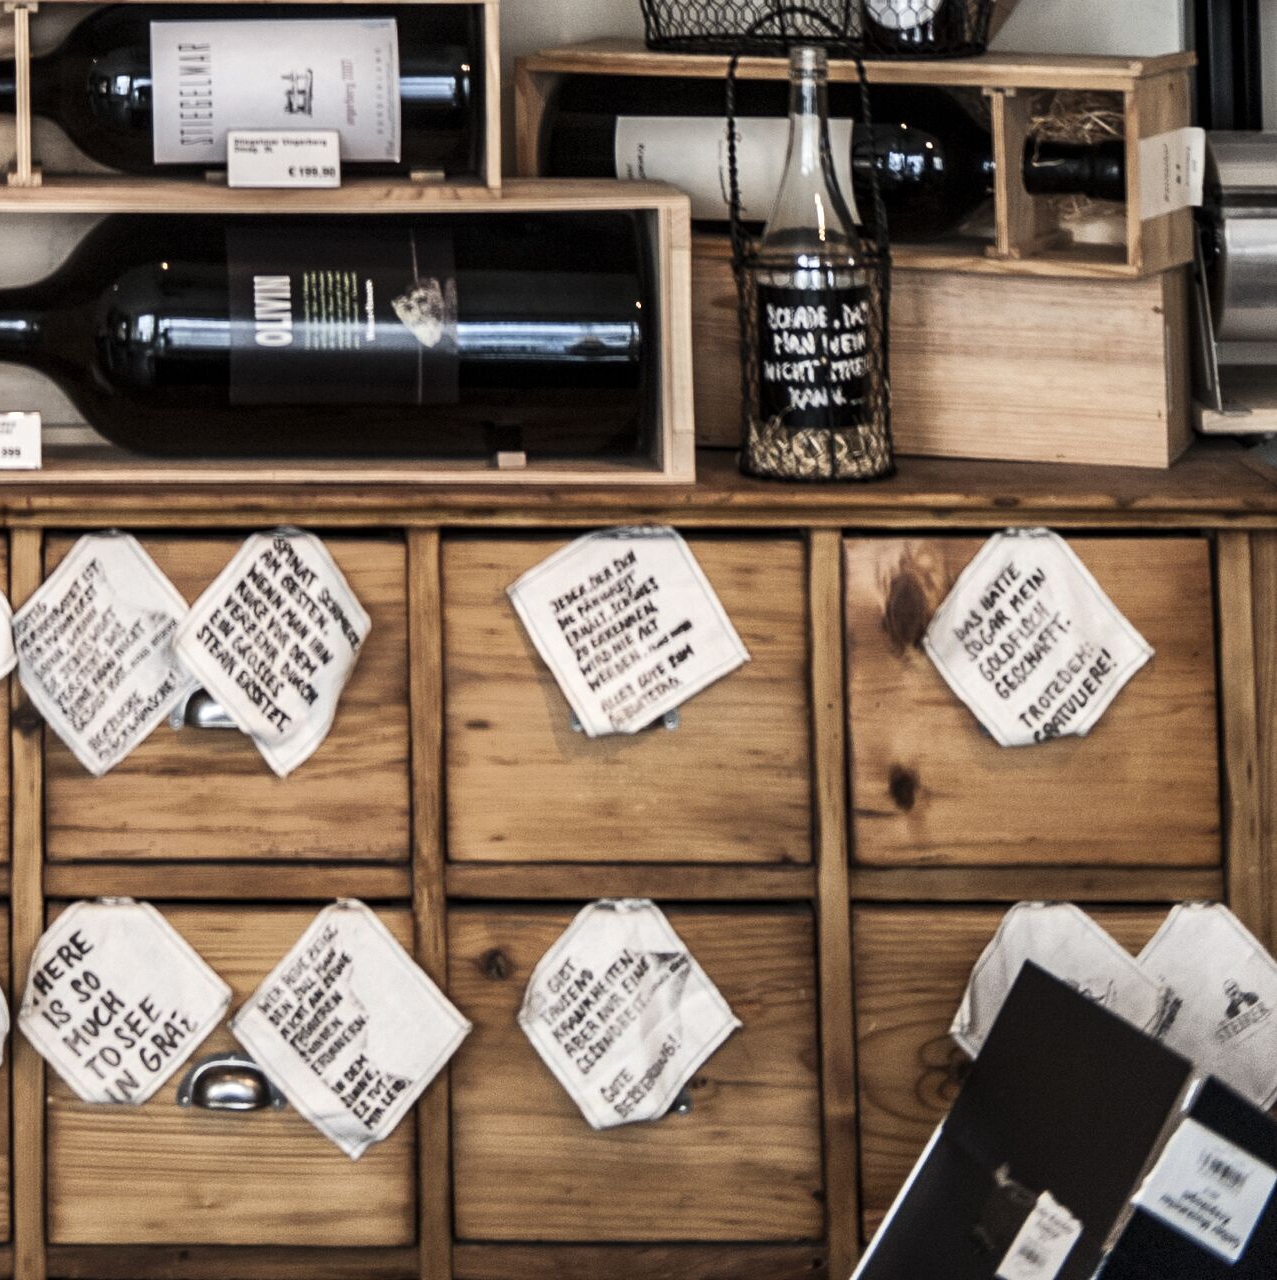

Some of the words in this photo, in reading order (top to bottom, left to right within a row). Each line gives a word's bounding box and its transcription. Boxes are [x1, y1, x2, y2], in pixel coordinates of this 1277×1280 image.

[252, 274, 293, 347] OLIVIN
[953, 610, 984, 642] DAS
[964, 609, 1012, 663] SOGAR
[1009, 567, 1048, 613] MEIN
[977, 600, 1051, 683] GOLDFISCH
[41, 996, 72, 1030] IS
[76, 969, 102, 1004] SO
[62, 986, 126, 1057] MUCH
[84, 1046, 121, 1082] TO
[123, 995, 163, 1052] SEE
